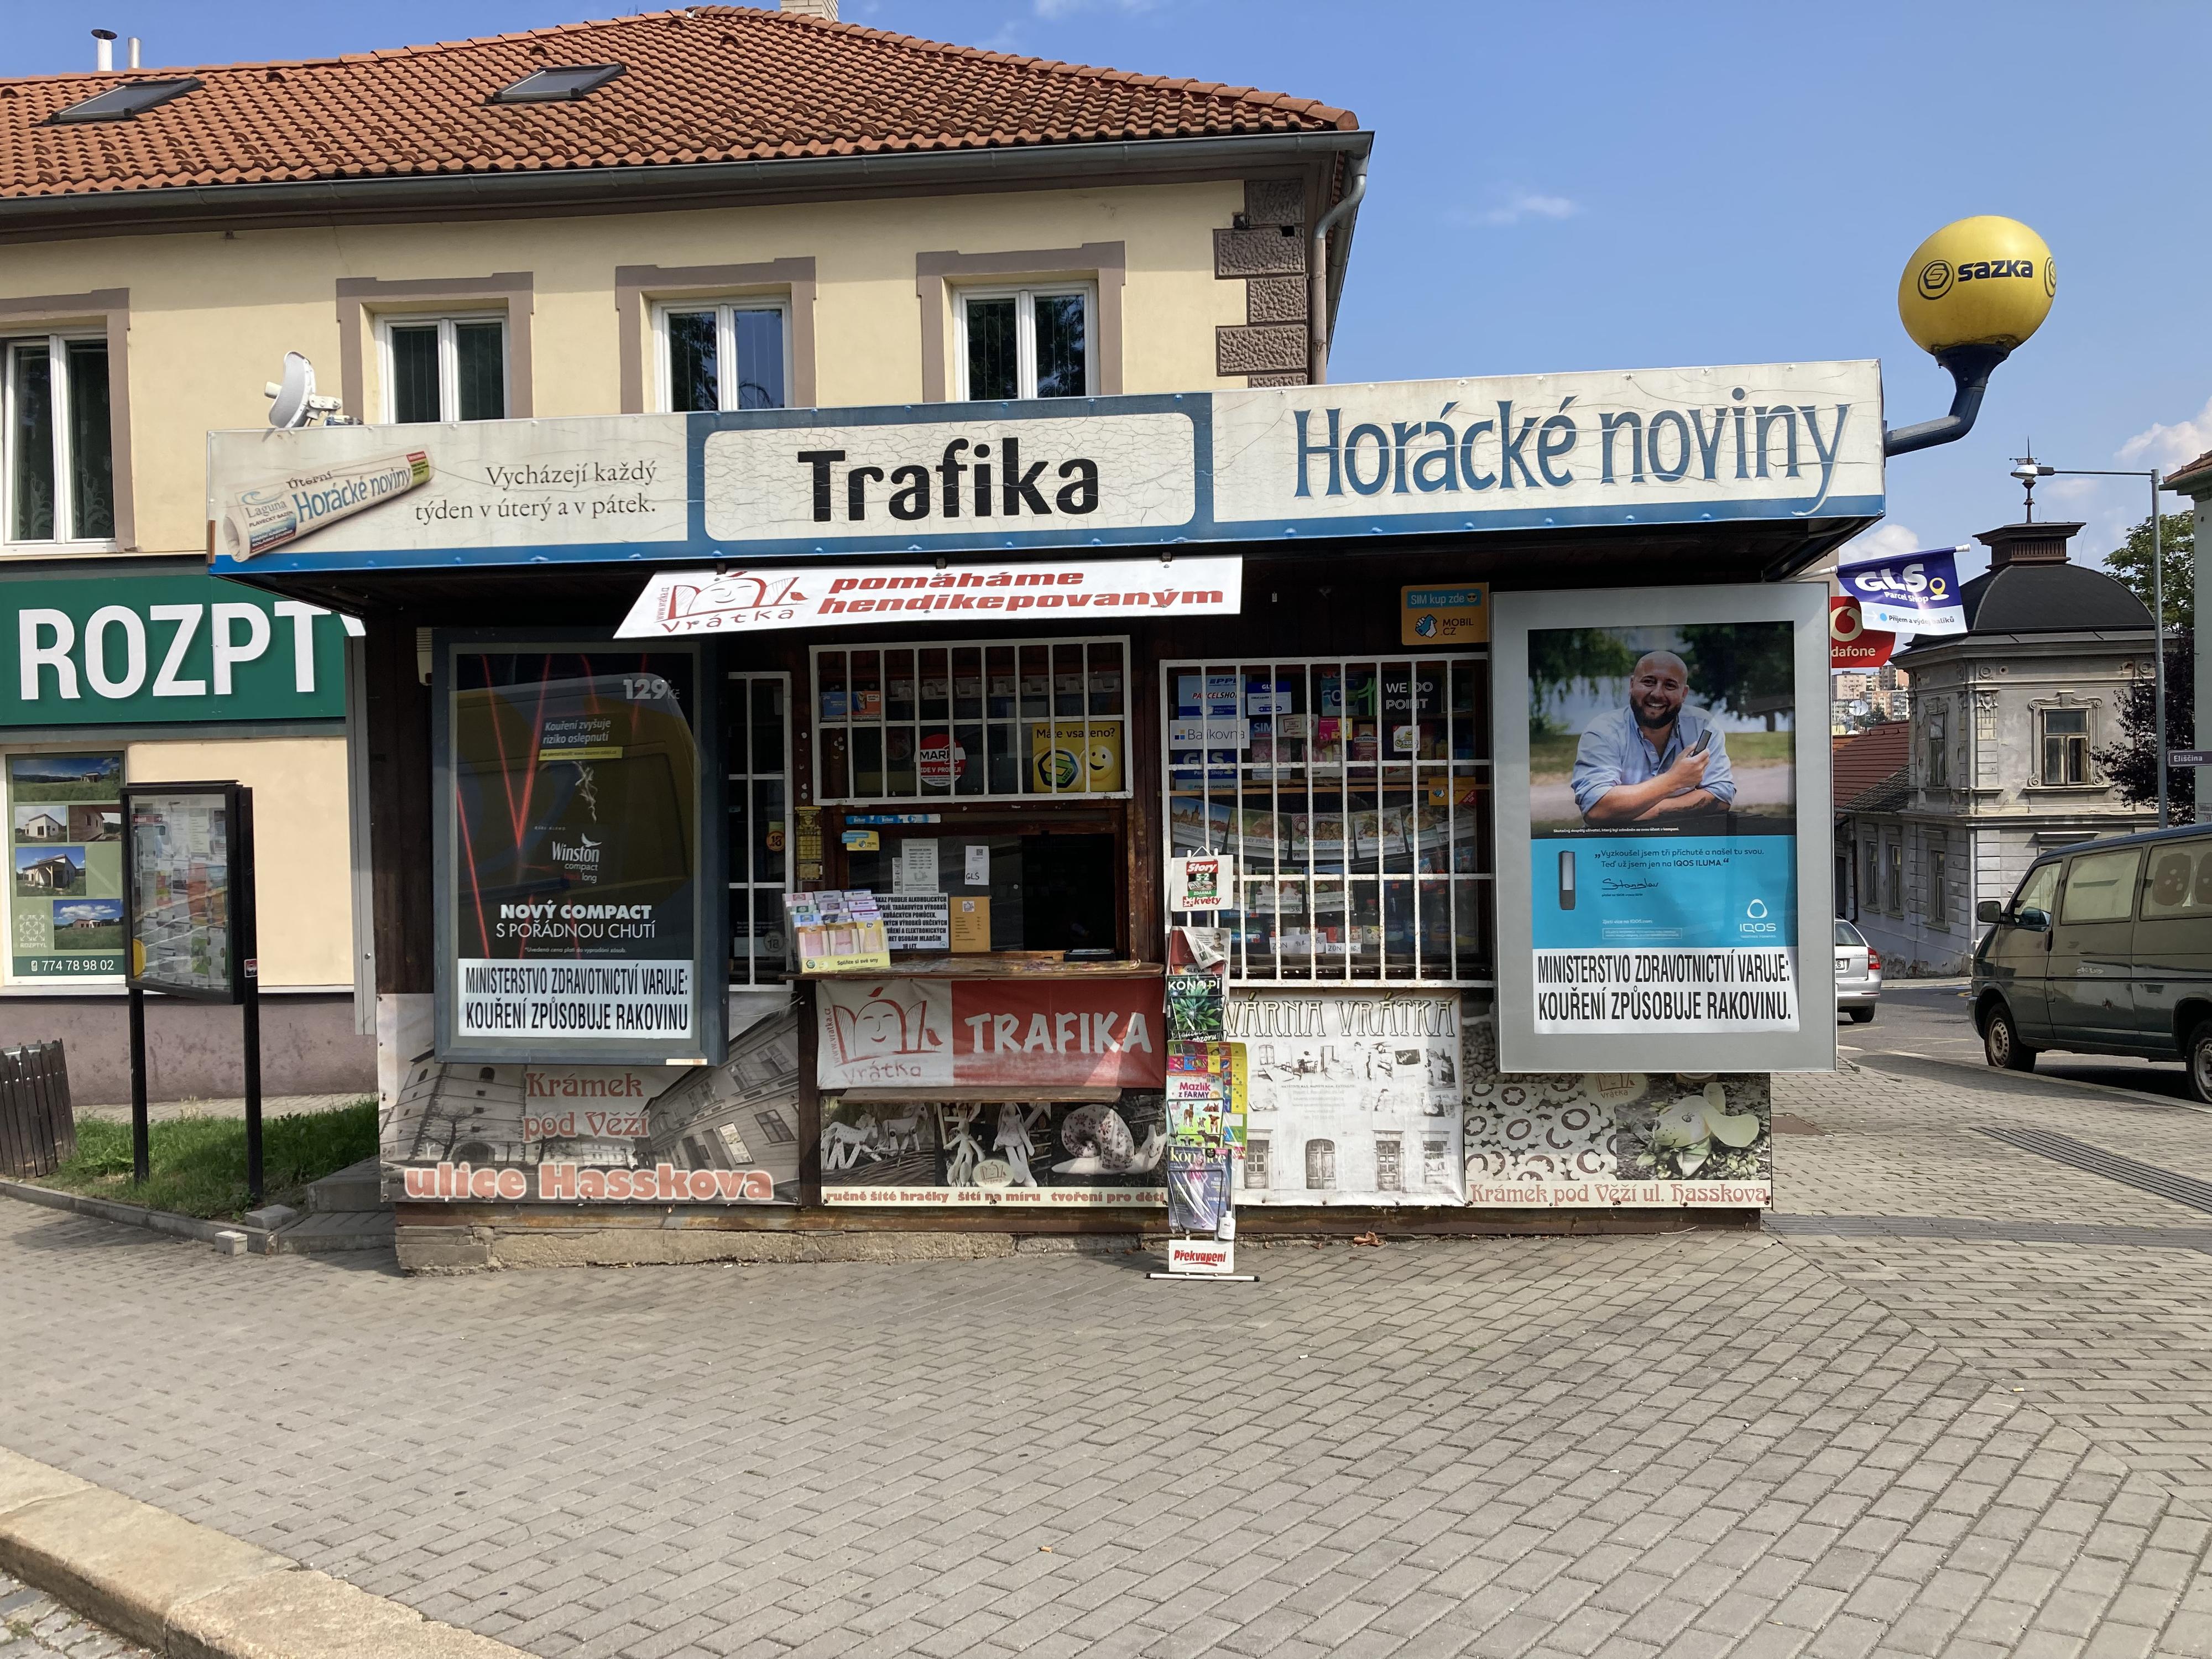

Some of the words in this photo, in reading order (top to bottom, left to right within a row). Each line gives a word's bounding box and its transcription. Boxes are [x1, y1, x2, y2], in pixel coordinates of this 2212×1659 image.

[1958, 259, 2033, 283] sazka
[1292, 394, 1578, 499] Horácké
[1599, 387, 1850, 517] noviny
[486, 463, 588, 491] Vycházejí
[593, 460, 658, 486] každý
[797, 436, 1099, 523] Trafika
[291, 476, 367, 523] Horácké
[371, 467, 413, 497] noviny
[245, 500, 287, 518] Laguna
[416, 499, 474, 525] týden
[479, 504, 491, 518] v
[498, 497, 552, 521] úterý
[557, 502, 568, 515] a
[575, 501, 586, 514] v
[592, 492, 656, 519] pátek.
[828, 571, 1084, 594] pomáháme
[1854, 563, 1928, 592] GLS
[816, 585, 1224, 615] hendikepovaným
[1411, 594, 1427, 605] SIM
[1430, 593, 1447, 606] kup
[1448, 593, 1465, 603] zde
[1884, 591, 1907, 601] Parcel
[1908, 594, 1929, 604] Shop
[1442, 618, 1474, 627] MOBIL
[1888, 614, 1908, 623] Příjem
[19, 600, 367, 701] ROZPT
[1831, 645, 1876, 657] dafone
[623, 678, 669, 700] 129
[1192, 691, 1237, 700] PACELSHO
[545, 719, 579, 731] Kouření
[579, 718, 612, 732] zvyšuje
[1036, 728, 1063, 739] Máe
[1066, 727, 1115, 738] vsaeno?
[1188, 728, 1245, 740] Baíkovna
[542, 733, 566, 744] riziko
[567, 731, 610, 745] oslepnutí
[2173, 754, 2203, 763] Eliščina
[551, 841, 601, 863] Winston
[1672, 848, 1703, 858] příchutě
[564, 863, 599, 873] compact
[1187, 863, 1218, 874] Story
[1627, 861, 1647, 869] jsem
[1648, 860, 1661, 869] jen
[581, 872, 598, 884] long
[966, 872, 980, 880] GLS
[500, 899, 557, 920] NOVÝ
[560, 904, 653, 920] COMPACT
[1194, 896, 1222, 905] květy
[496, 922, 505, 938] S
[509, 919, 604, 938] POŘÁDNOU
[608, 920, 656, 938] CHUTÍ
[1739, 923, 1777, 933] IQOS
[41, 960, 62, 972] 774
[65, 960, 80, 971] 78
[83, 959, 98, 971] 98
[100, 959, 115, 971] 02
[1538, 954, 1631, 983] MINISTERSTVO
[1635, 949, 1736, 983] ZDRAVOTNICTVÍ
[1738, 953, 1790, 983] VARUJE:
[466, 967, 547, 995] MINISTERSTVO
[551, 963, 639, 995] ZDRAVOTNICTVÍ
[641, 968, 688, 995] VARUJE:
[1538, 986, 1608, 1021] KOUŘENÍ
[1611, 985, 1702, 1020] ZPŮSOBUJE
[1707, 991, 1792, 1020] RAKOVINU.
[466, 997, 528, 1029] KOUŘENÍ
[531, 995, 611, 1030] ZPŮSOBUJE
[616, 1003, 688, 1031] RAKOVINU
[1223, 991, 1326, 1037] VÁRNA
[1337, 991, 1455, 1037] VRÁTKA
[964, 1010, 1154, 1055] TRAFIKA
[525, 1072, 645, 1099] Krámek
[523, 1112, 576, 1143] pod
[583, 1109, 650, 1139] Věží
[404, 1162, 528, 1200] ulice
[538, 1162, 776, 1202] Hasskova
[826, 1190, 868, 1203] ručně
[870, 1190, 897, 1202] šité
[900, 1191, 950, 1203] hračky
[957, 1190, 982, 1202] šití
[984, 1192, 1003, 1203] na
[1005, 1190, 1041, 1202] míru
[1051, 1190, 1104, 1202] tvoření
[1106, 1192, 1133, 1204] pro
[1135, 1190, 1166, 1203] děti
[1470, 1183, 1548, 1203] Krámek
[1553, 1184, 1590, 1206] pod
[1595, 1182, 1637, 1203] Věží
[1643, 1184, 1665, 1202] ul.
[1173, 1248, 1227, 1264] Překvapení
